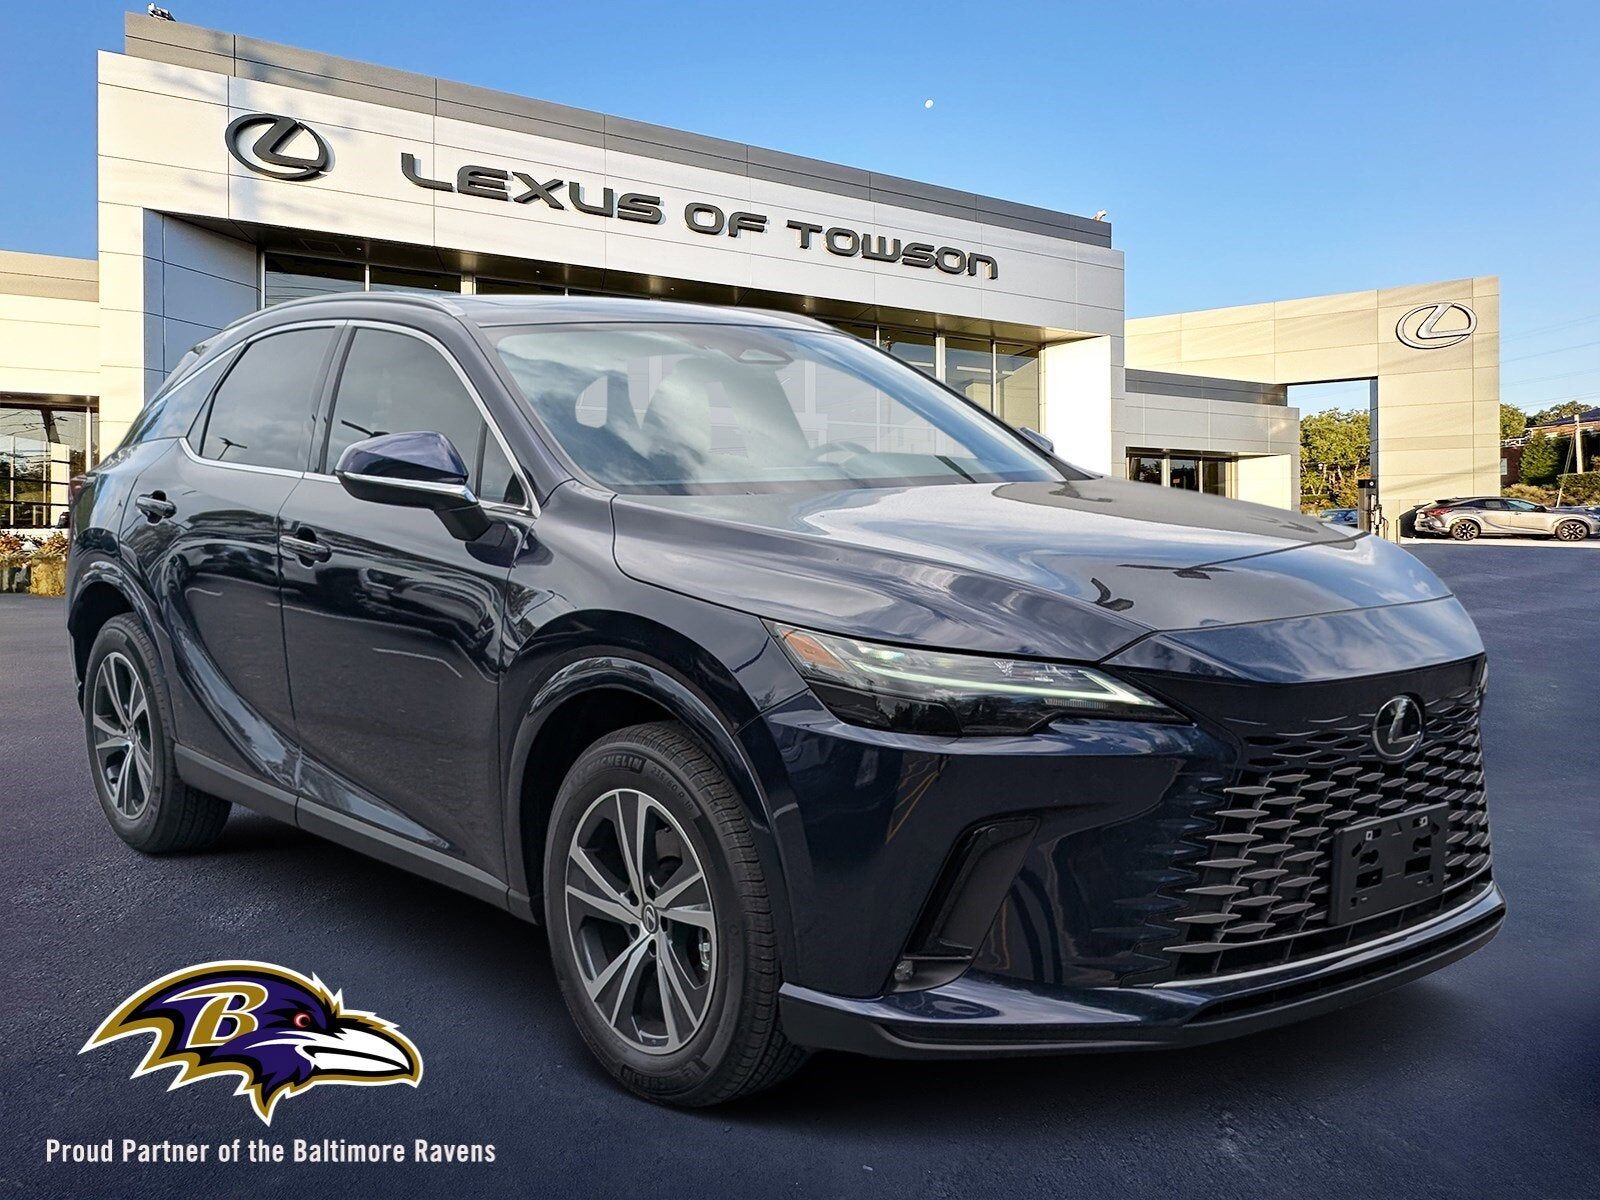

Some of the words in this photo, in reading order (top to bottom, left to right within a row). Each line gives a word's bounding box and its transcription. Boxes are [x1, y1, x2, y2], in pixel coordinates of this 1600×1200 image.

[400, 152, 664, 225] LEXUS
[684, 202, 767, 238] OF
[786, 219, 999, 280] TOWSON
